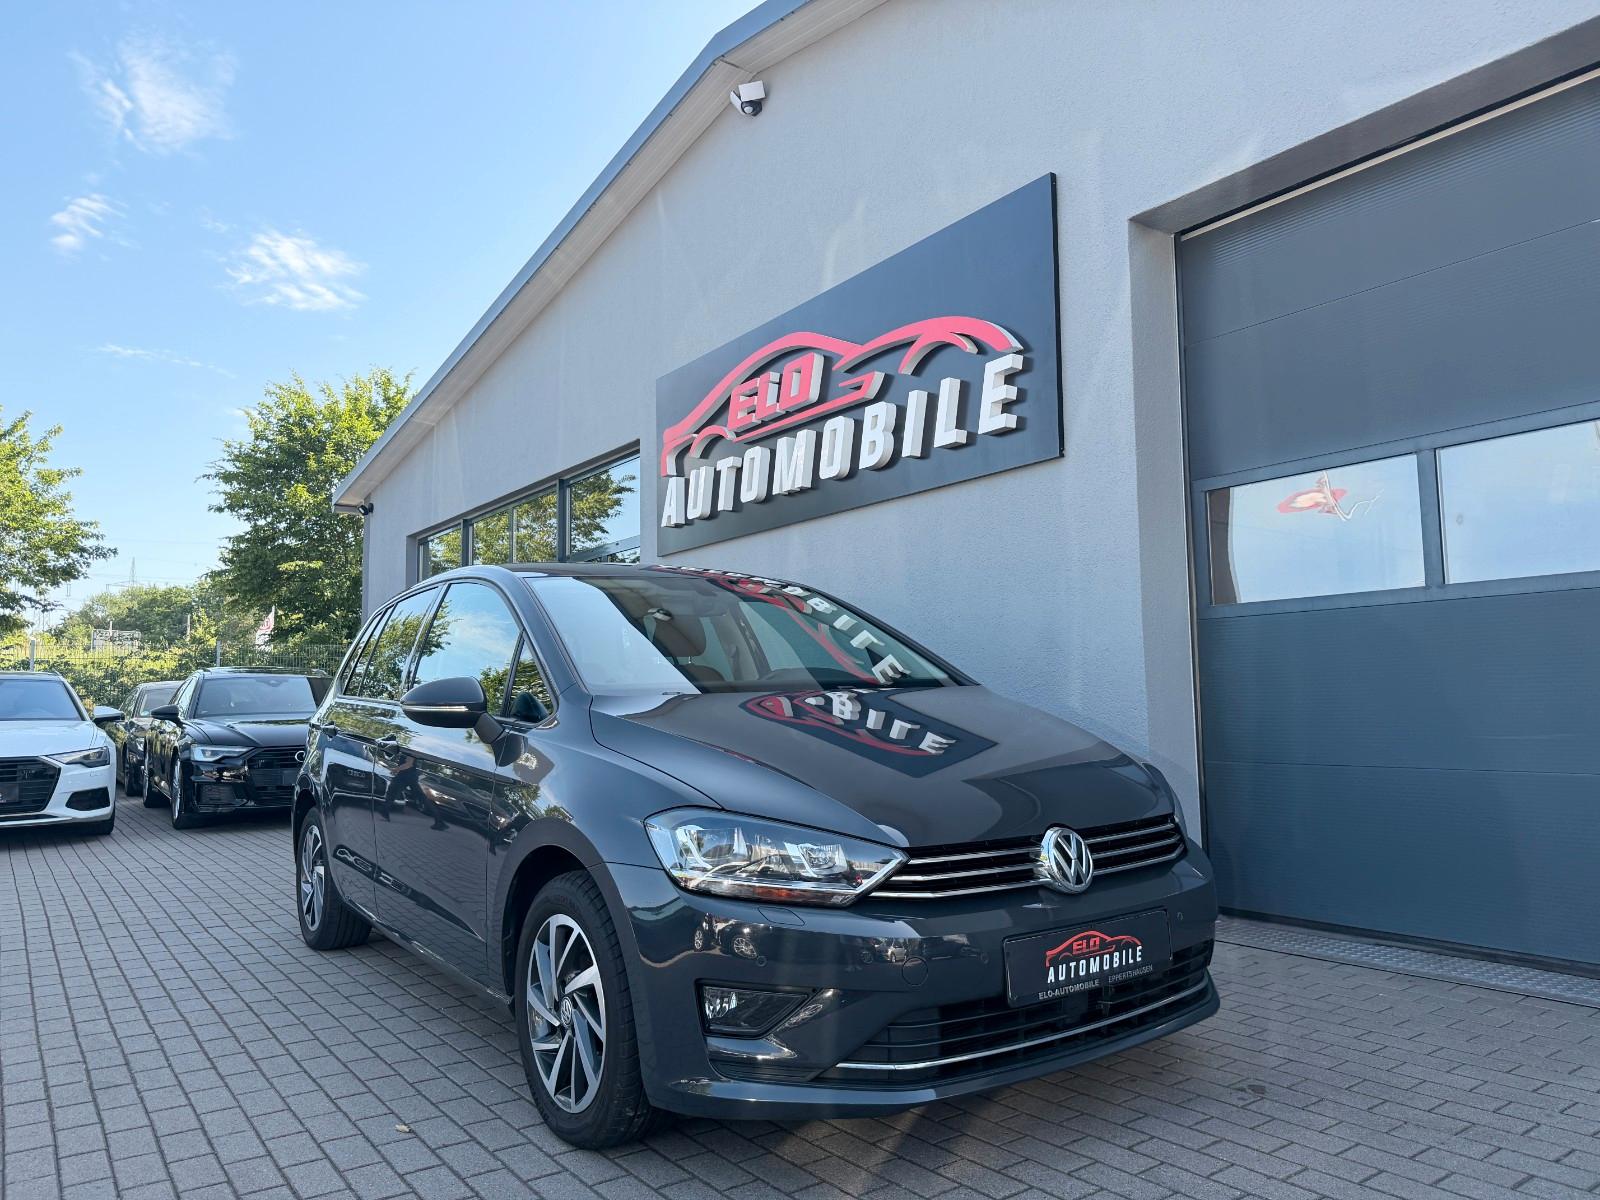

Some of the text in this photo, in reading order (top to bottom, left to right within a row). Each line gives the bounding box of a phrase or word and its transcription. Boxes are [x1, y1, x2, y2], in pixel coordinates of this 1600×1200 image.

[661, 353, 1025, 528] AUTOMOBILE
[1072, 937, 1100, 955] ELO
[1047, 945, 1143, 984] AUTOMOBILE
[1038, 979, 1100, 1000] ELO-AUTOMOBILE
